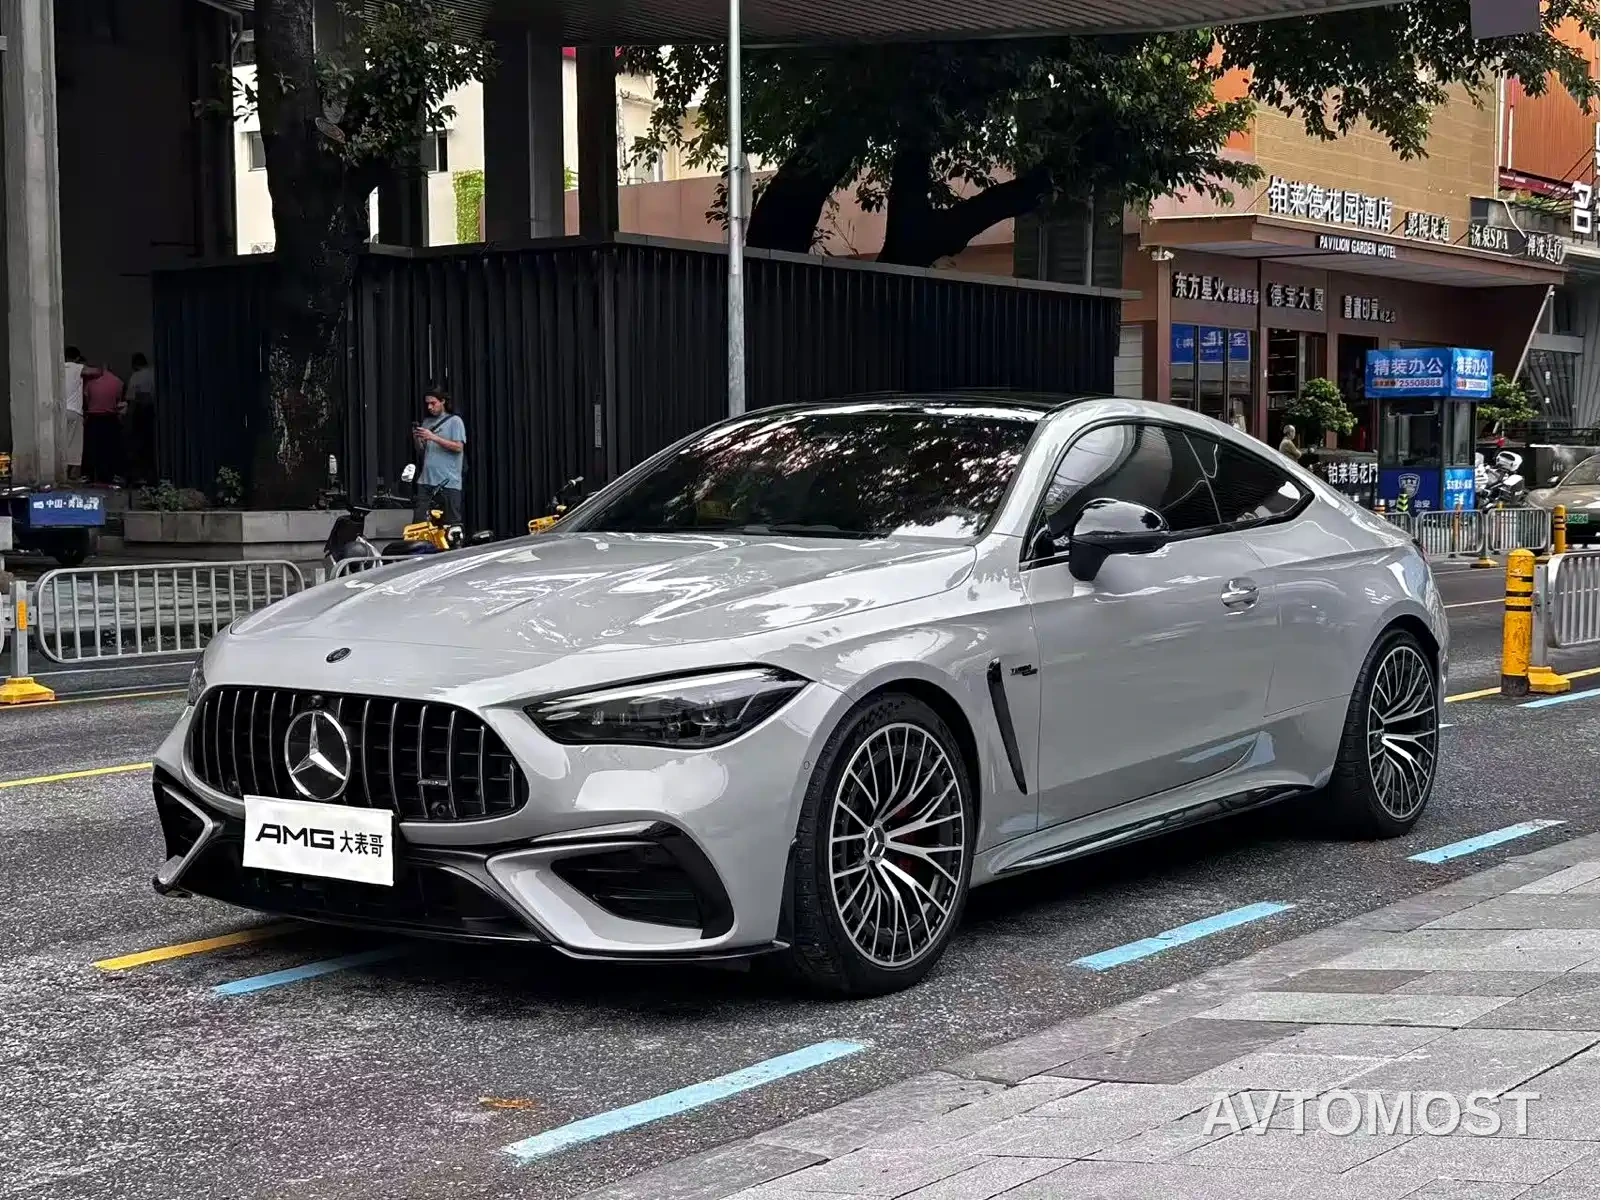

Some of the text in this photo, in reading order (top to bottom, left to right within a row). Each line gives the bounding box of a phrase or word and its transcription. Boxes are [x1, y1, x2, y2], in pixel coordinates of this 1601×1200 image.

[1268, 176, 1392, 230] 铂莱德花园酒店
[1320, 236, 1396, 258] PAVILION GARDEN HOTEL
[1175, 272, 1225, 300] 东方星火
[1271, 284, 1324, 311] 德宝大厦
[1373, 357, 1443, 375] 精装办公
[1456, 356, 1488, 376] 精装办公
[255, 823, 384, 858] AMG 大表哥
